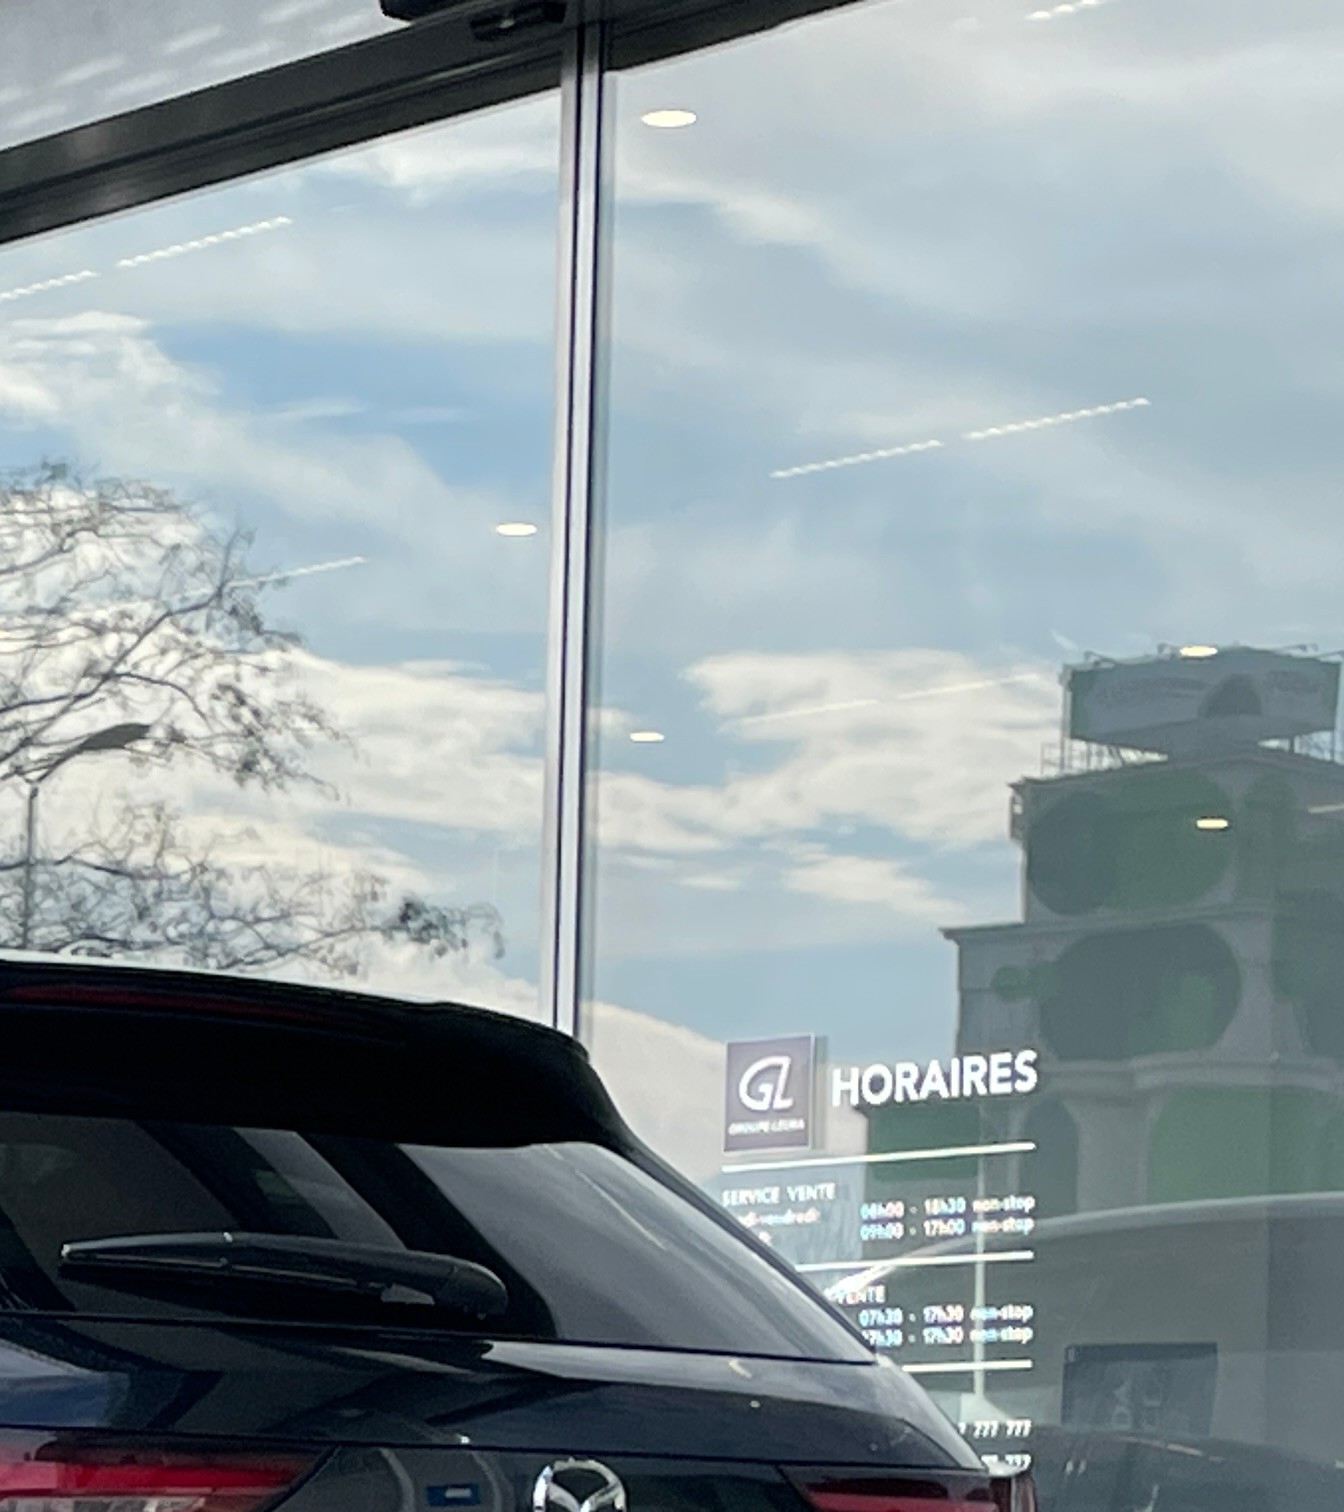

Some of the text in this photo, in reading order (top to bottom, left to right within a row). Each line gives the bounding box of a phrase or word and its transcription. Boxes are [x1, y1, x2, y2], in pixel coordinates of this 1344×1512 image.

[832, 1050, 1038, 1107] HORAIRES
[722, 1182, 836, 1206] SERVICE VENTE
[972, 1195, 1035, 1213] non-stop
